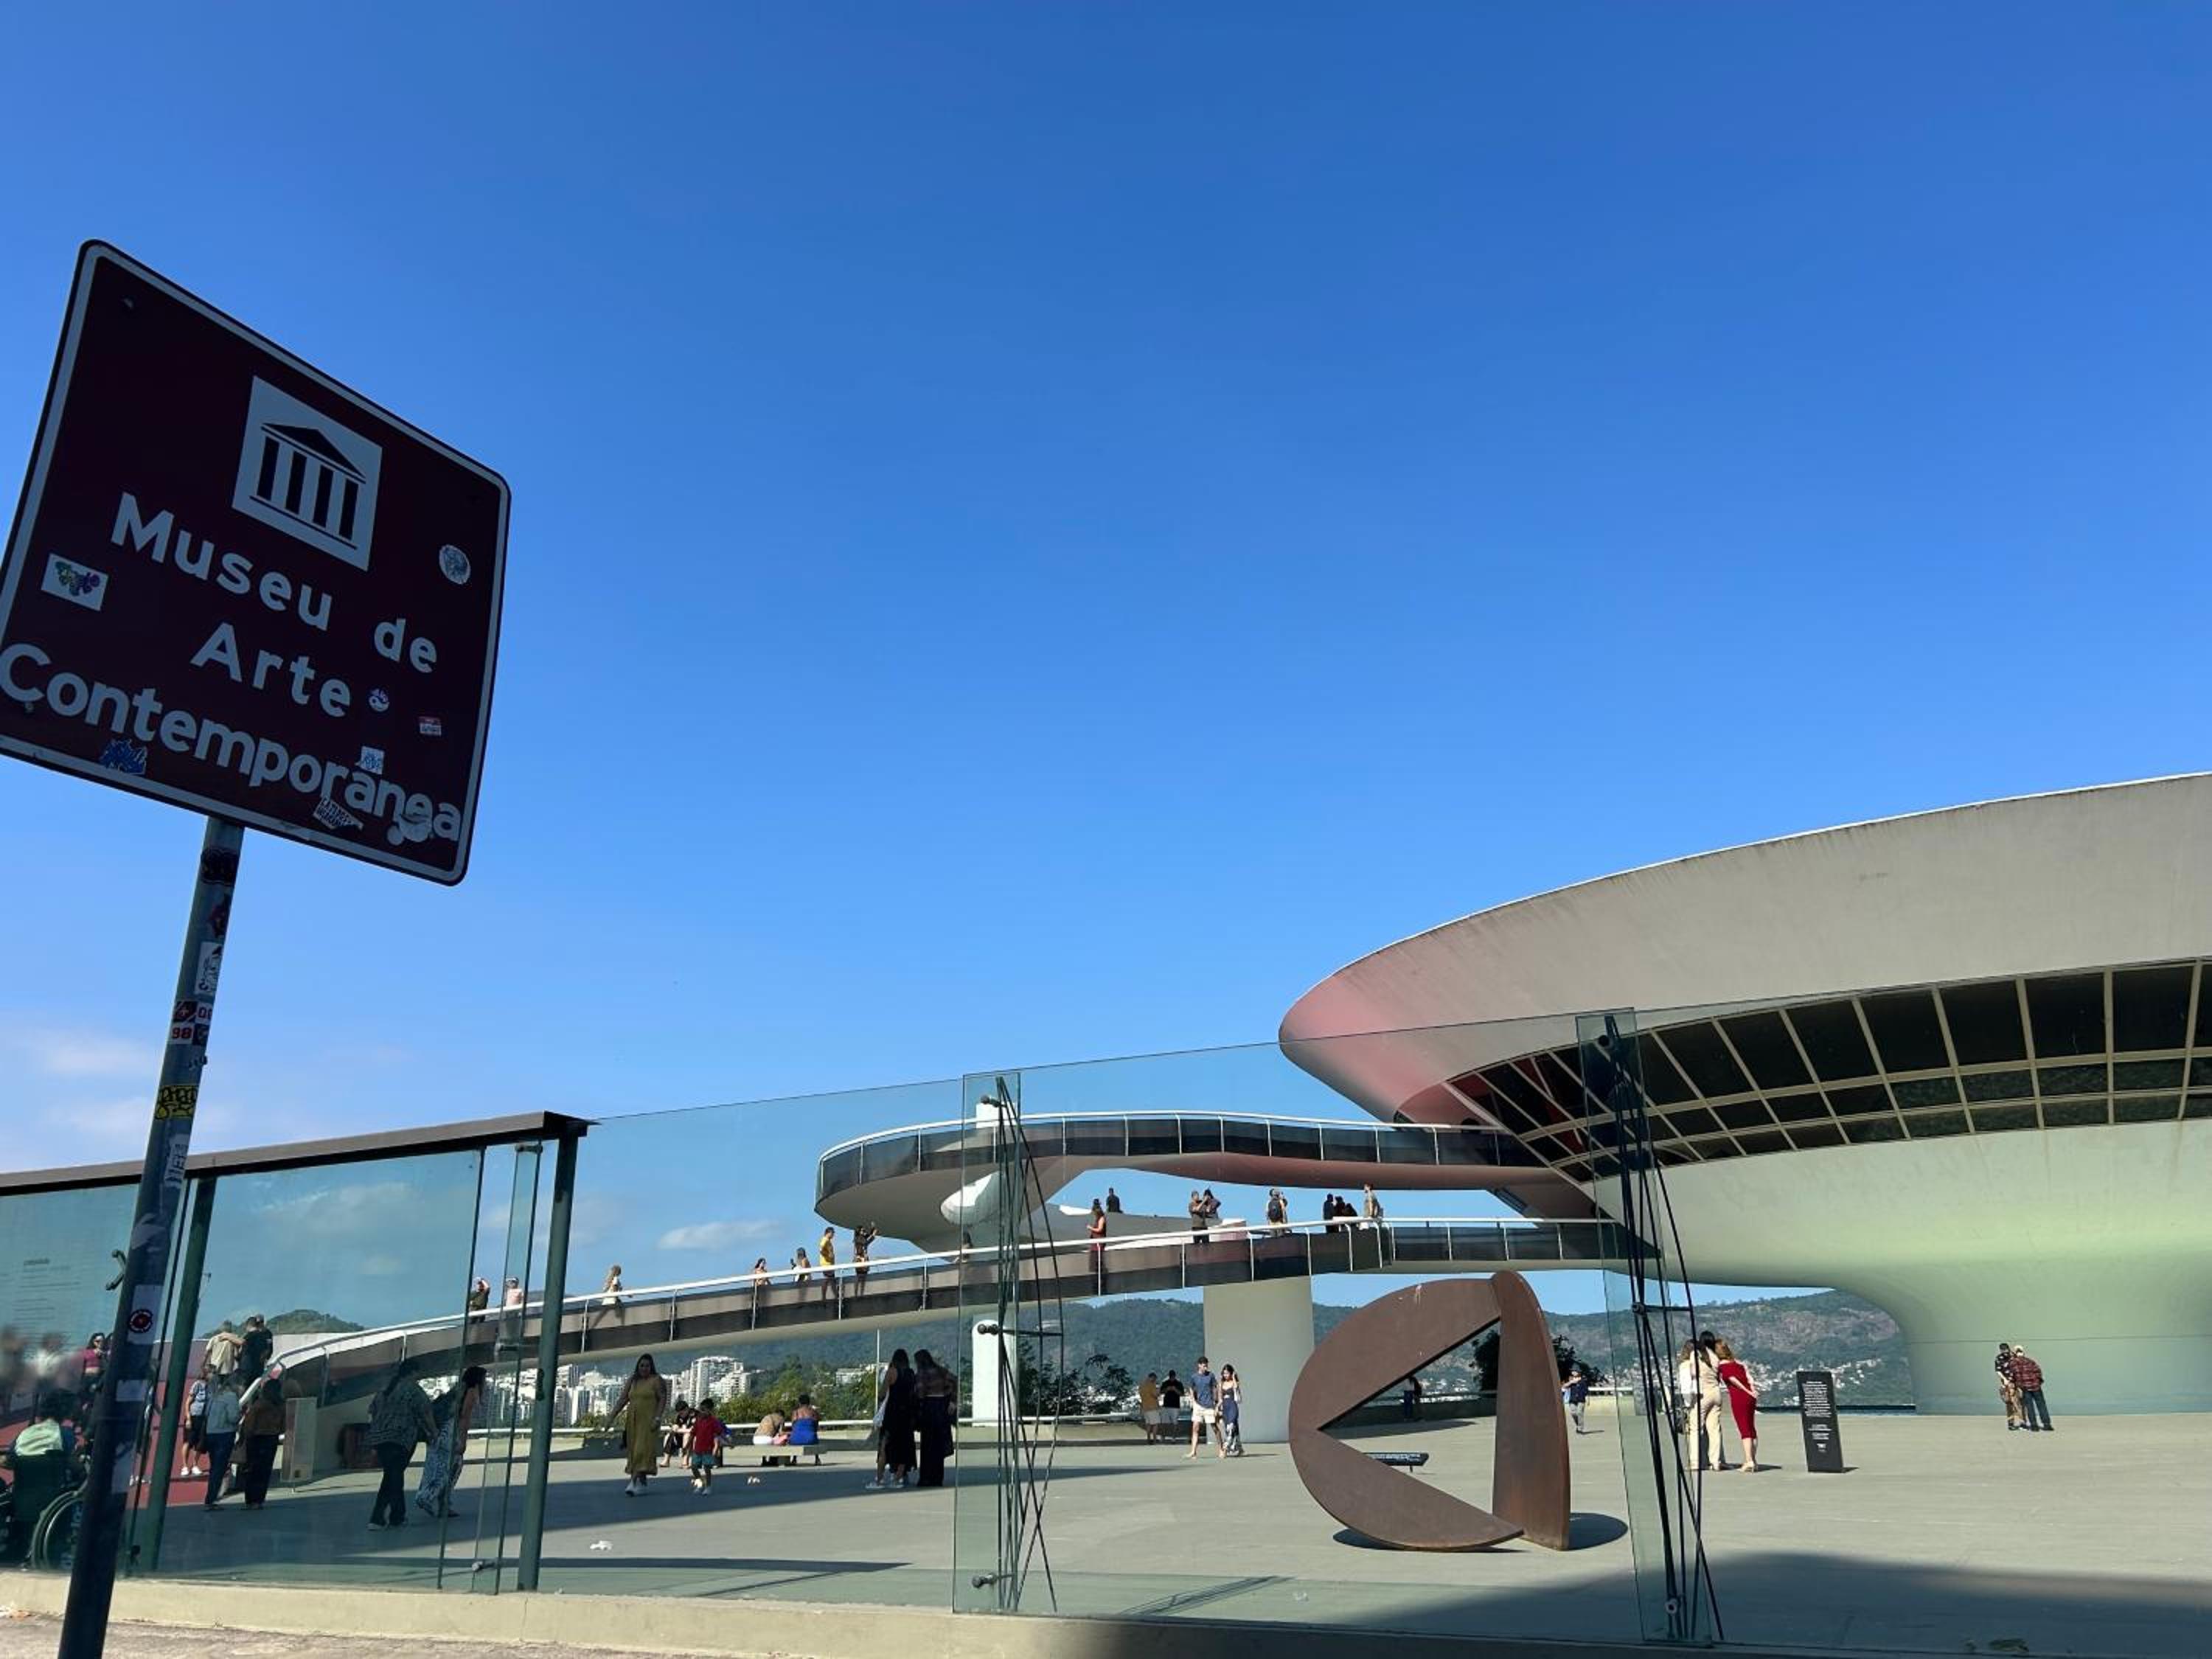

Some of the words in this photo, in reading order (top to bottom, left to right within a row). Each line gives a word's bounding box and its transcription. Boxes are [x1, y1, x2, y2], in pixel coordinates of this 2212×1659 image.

[111, 492, 333, 631] Museu
[374, 618, 438, 673] de
[190, 622, 351, 717] Arte
